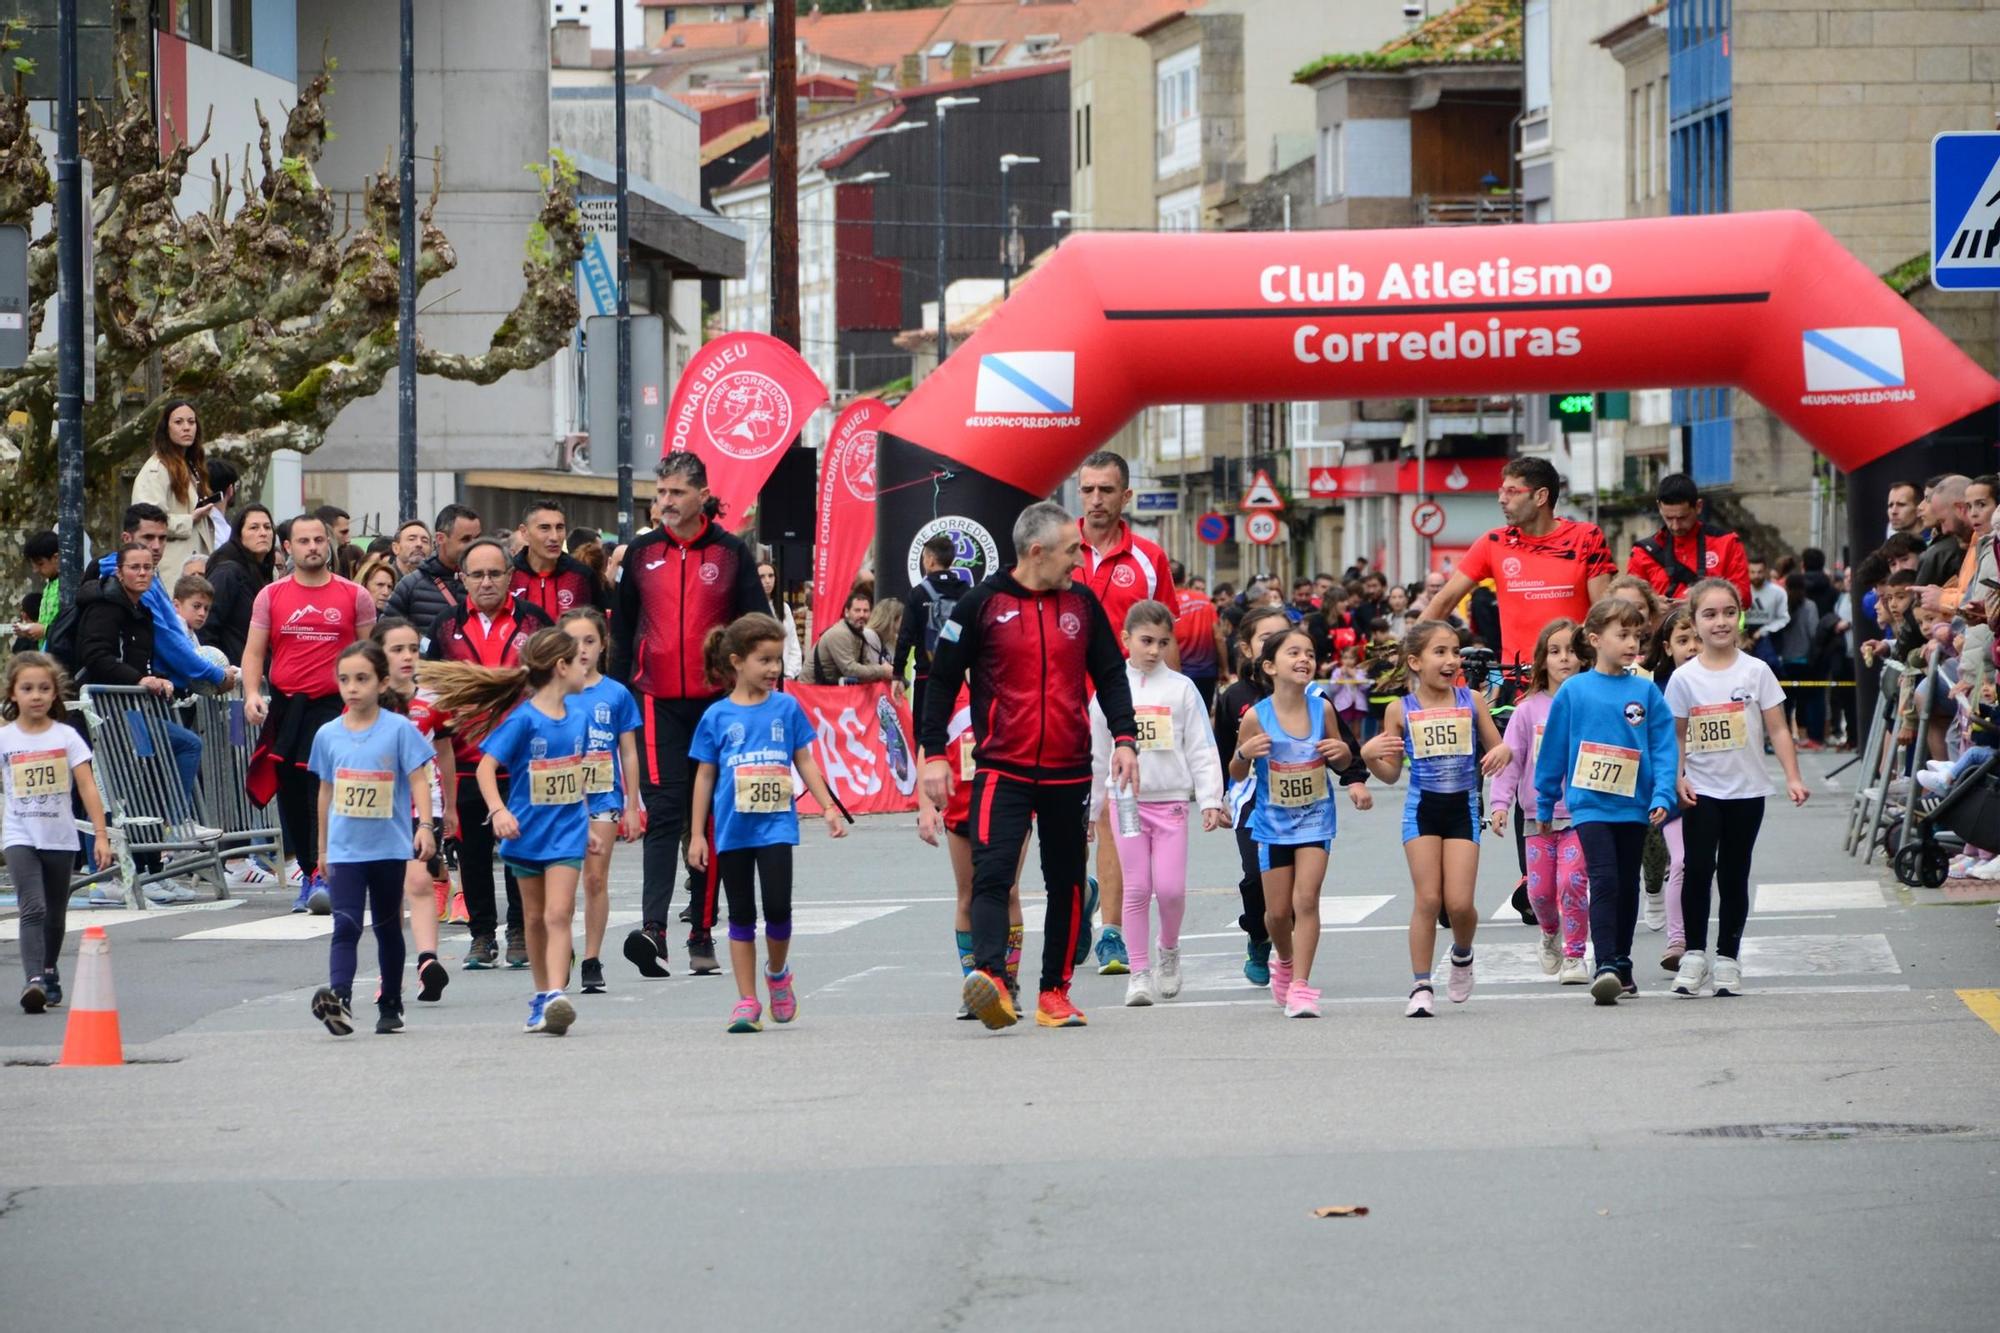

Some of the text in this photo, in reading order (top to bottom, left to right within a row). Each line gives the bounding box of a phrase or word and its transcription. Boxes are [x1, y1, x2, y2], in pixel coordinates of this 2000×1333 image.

[579, 201, 618, 210] Centr
[581, 211, 616, 221] Socia
[599, 223, 616, 232] Ma
[585, 243, 618, 313] AFETER
[1260, 257, 1612, 302] Club Atletismo
[1293, 317, 1582, 364] Corredoiras
[702, 342, 748, 382] BUEU
[708, 383, 730, 416] CLUBE
[734, 376, 787, 427] CORREDOIRAS
[965, 416, 1081, 428] #EUSONCORREDOIRAS
[821, 438, 845, 545] CORREDOIRAS
[841, 408, 870, 437] BUEU
[1254, 523, 1272, 534] 30
[910, 519, 998, 572] CLUBE CORREDOIRAS
[1507, 580, 1545, 588] Atletismo
[1136, 721, 1156, 741] 85
[1424, 725, 1457, 746] 365
[1700, 720, 1731, 742] 386
[25, 766, 56, 787] 379
[582, 767, 597, 785] 71
[1590, 760, 1623, 784] 377
[545, 773, 576, 796] 370
[750, 782, 781, 802] 369
[1280, 776, 1313, 798] 366
[345, 786, 377, 808] 372
